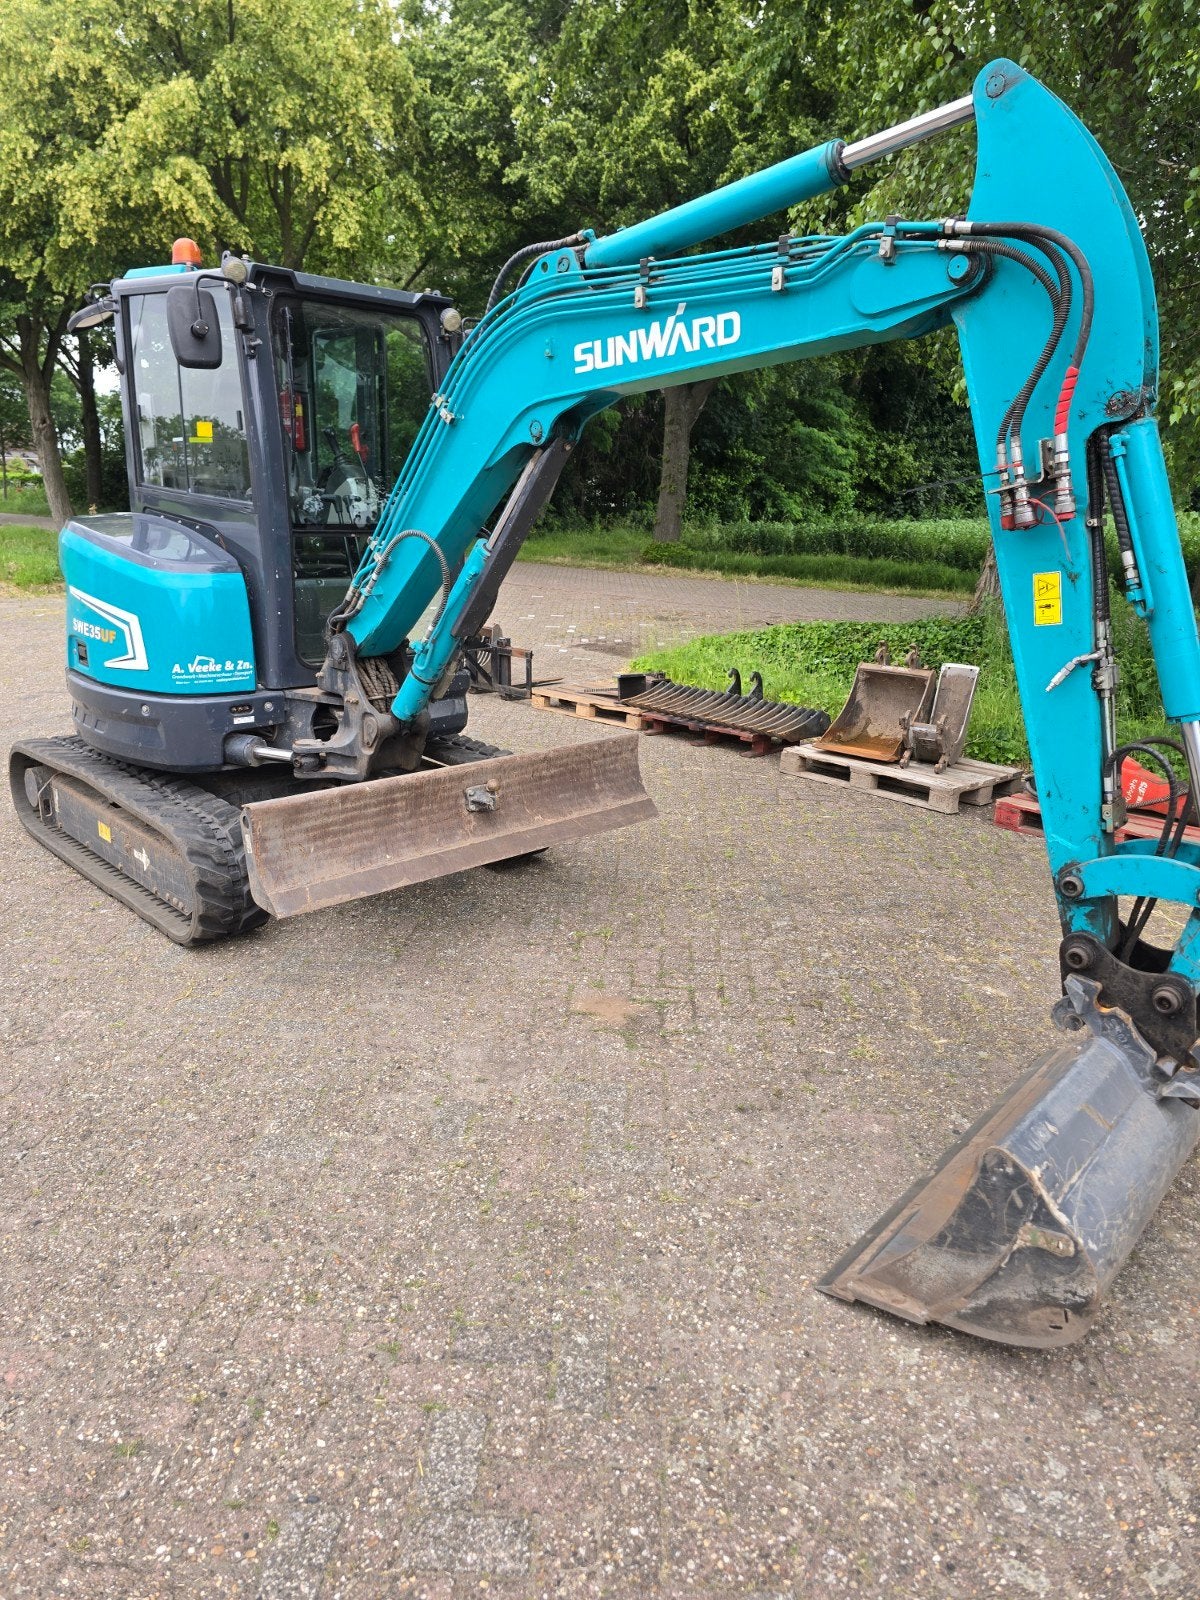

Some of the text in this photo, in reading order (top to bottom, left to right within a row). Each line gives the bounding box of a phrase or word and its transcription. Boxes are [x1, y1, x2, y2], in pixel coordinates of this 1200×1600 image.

[574, 303, 741, 374] SUNWARD
[72, 618, 116, 643] SWE35UF
[172, 659, 253, 674] A. Veeke & Zn.
